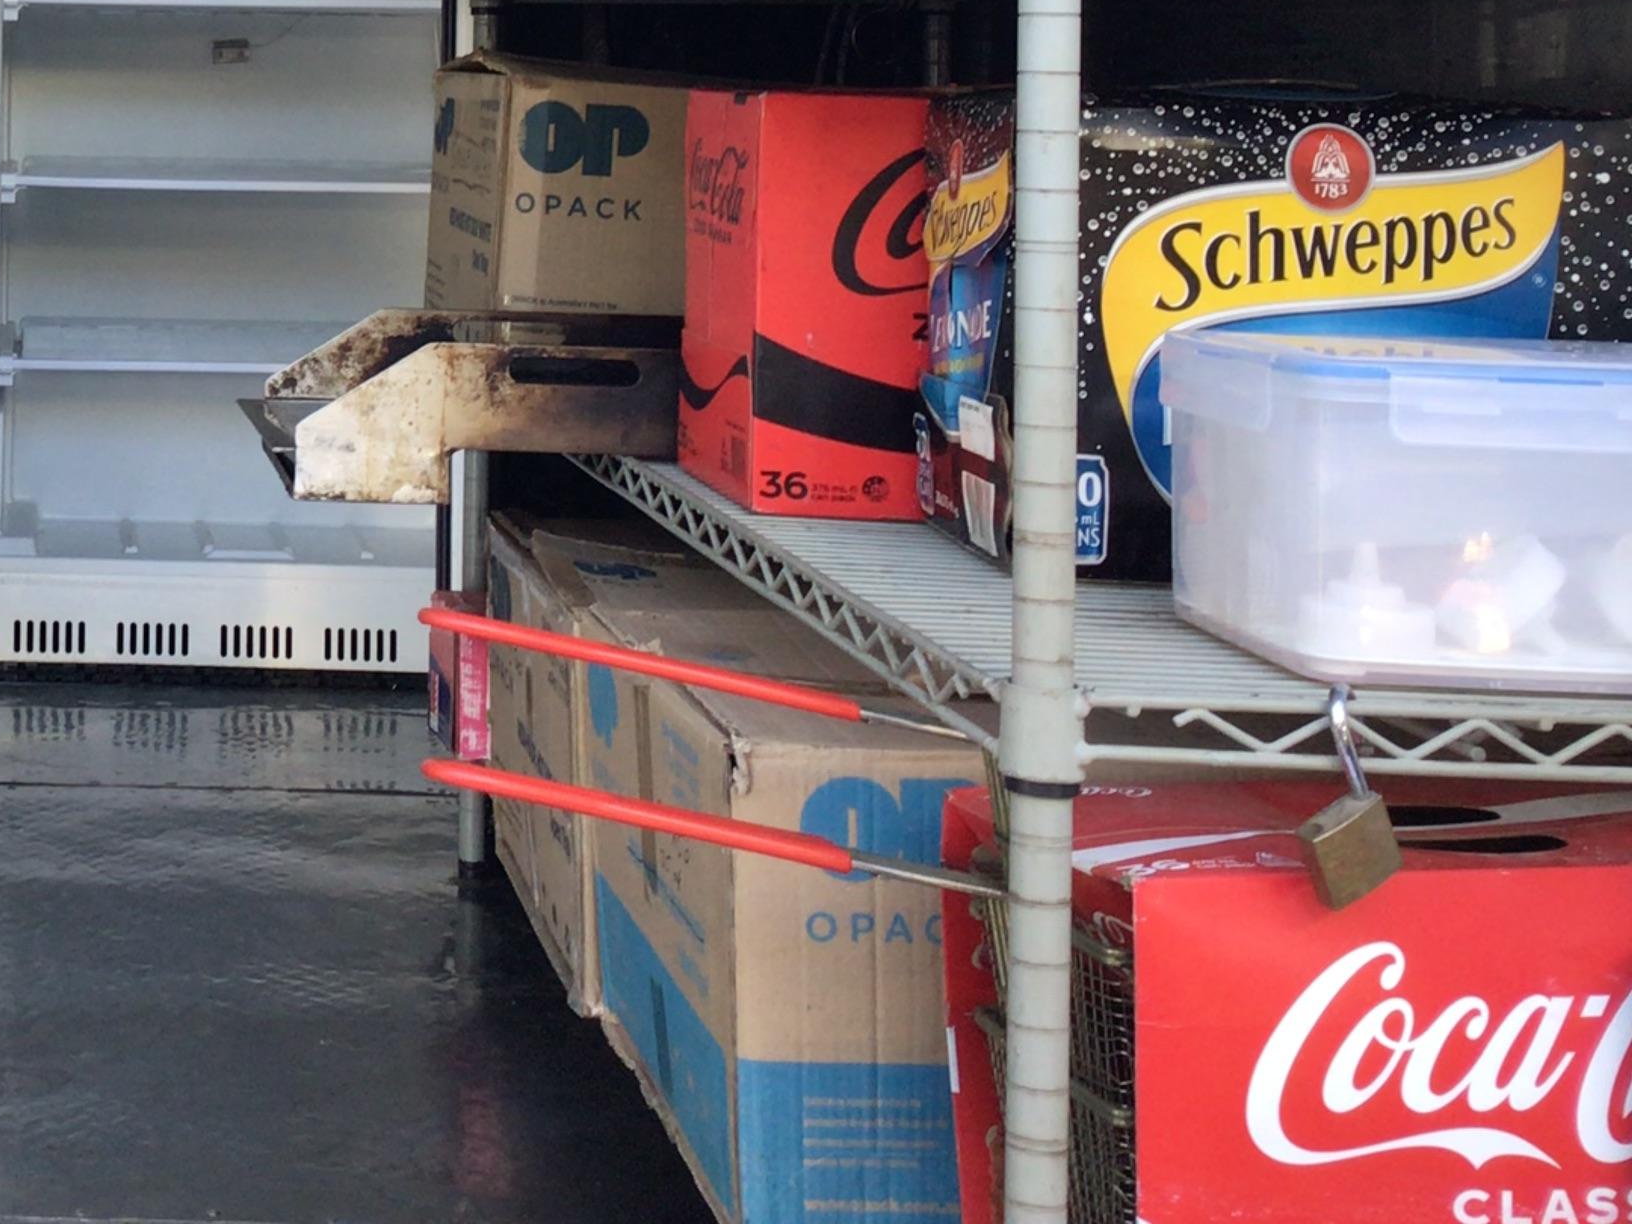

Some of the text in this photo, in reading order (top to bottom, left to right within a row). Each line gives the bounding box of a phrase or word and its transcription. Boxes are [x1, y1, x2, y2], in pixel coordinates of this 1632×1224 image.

[519, 100, 650, 177] OP
[515, 192, 642, 222] OPACK
[1314, 182, 1348, 200] 1783
[1154, 197, 1516, 313] Schweppes
[759, 470, 809, 500] 36
[1078, 470, 1103, 508] 0
[1077, 527, 1101, 548] NS
[806, 910, 942, 944] OPAC
[1452, 1188, 1632, 1224] CLAS
